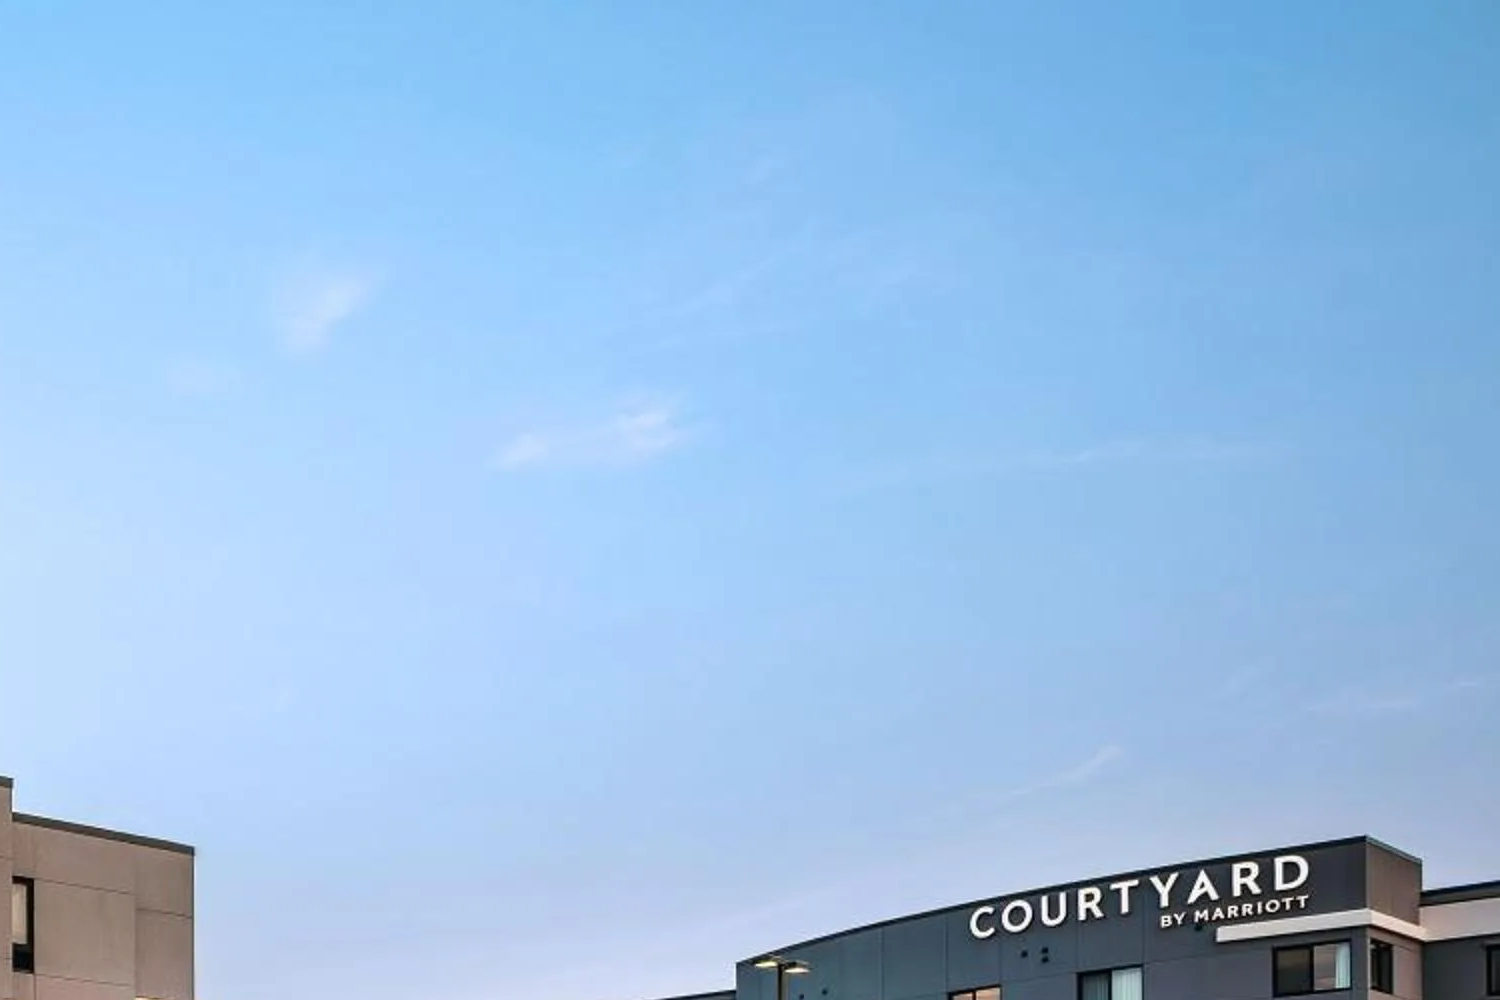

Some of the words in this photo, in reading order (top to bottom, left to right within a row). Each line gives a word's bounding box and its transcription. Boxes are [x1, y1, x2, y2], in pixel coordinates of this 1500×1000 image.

[969, 855, 1310, 940] COURTYARD
[1160, 914, 1187, 929] BY
[1195, 895, 1310, 923] MARRIOTT
